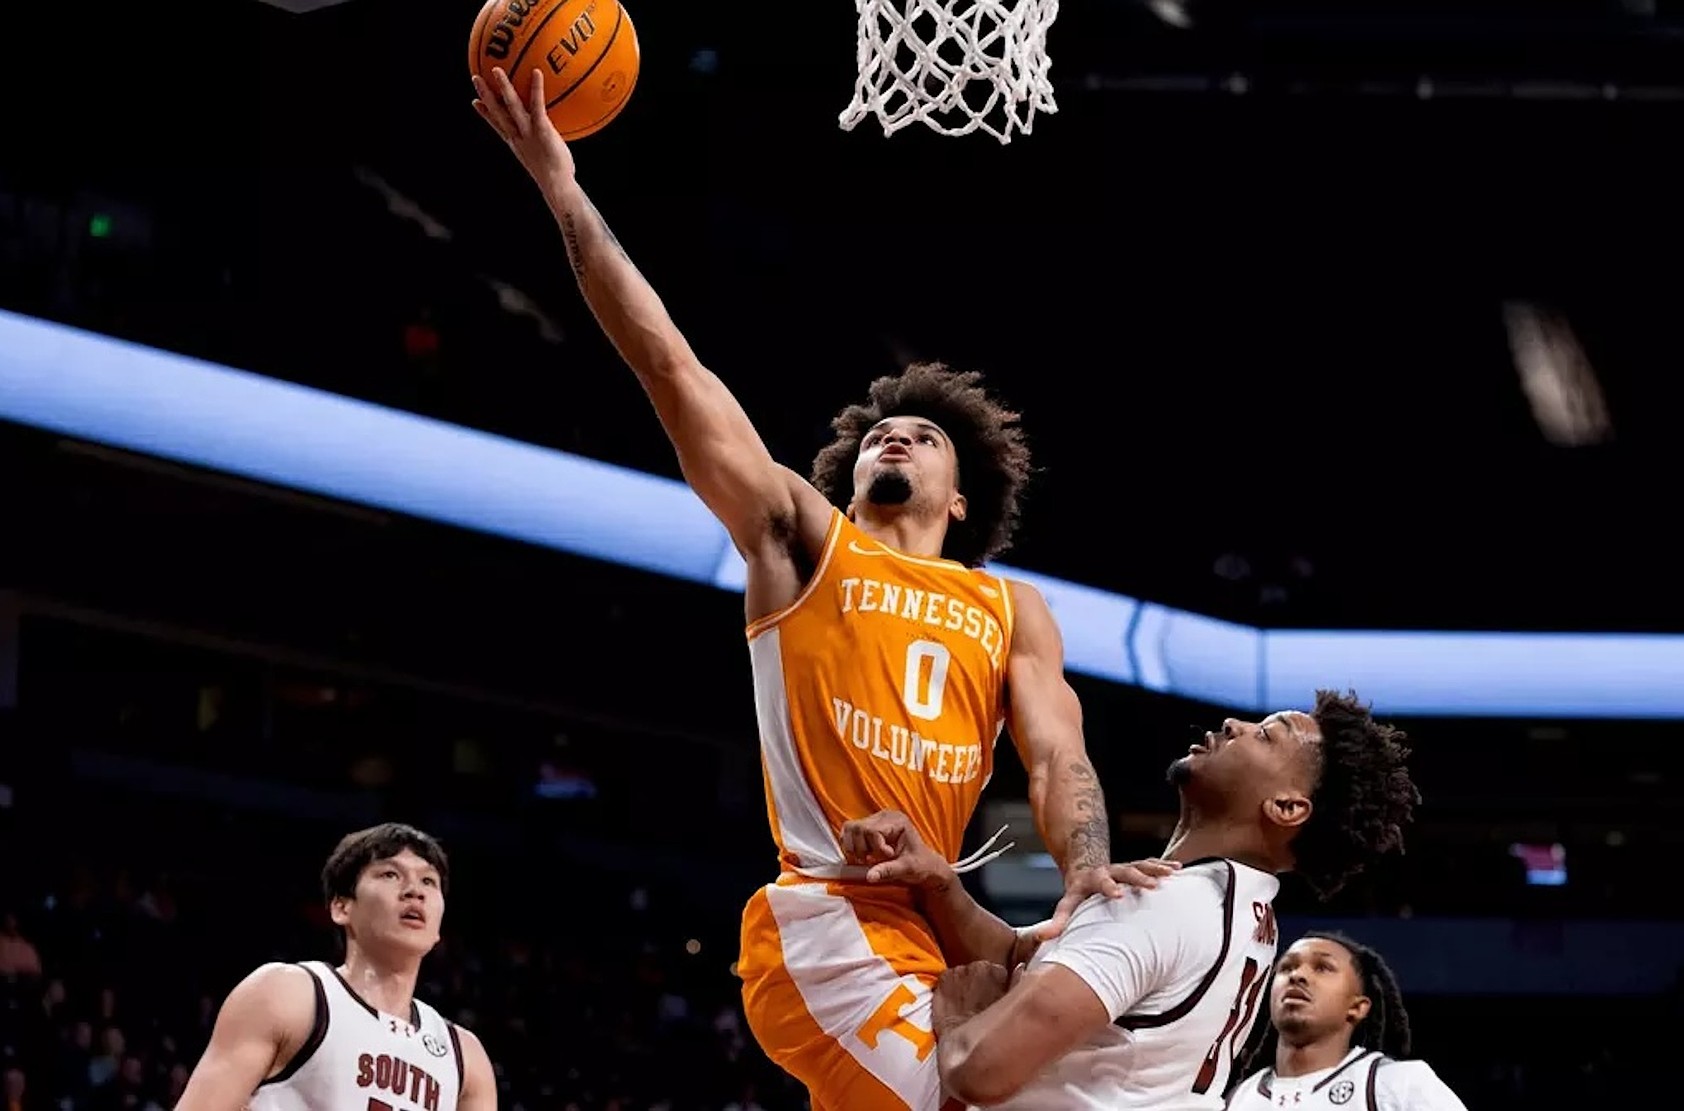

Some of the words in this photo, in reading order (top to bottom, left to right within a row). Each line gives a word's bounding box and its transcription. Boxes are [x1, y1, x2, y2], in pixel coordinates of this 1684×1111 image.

[546, 12, 596, 75] EVO
[903, 639, 950, 721] 0
[832, 697, 982, 784] VOLUNTEER
[855, 983, 937, 1063] T
[356, 1053, 441, 1111] SOUTH
